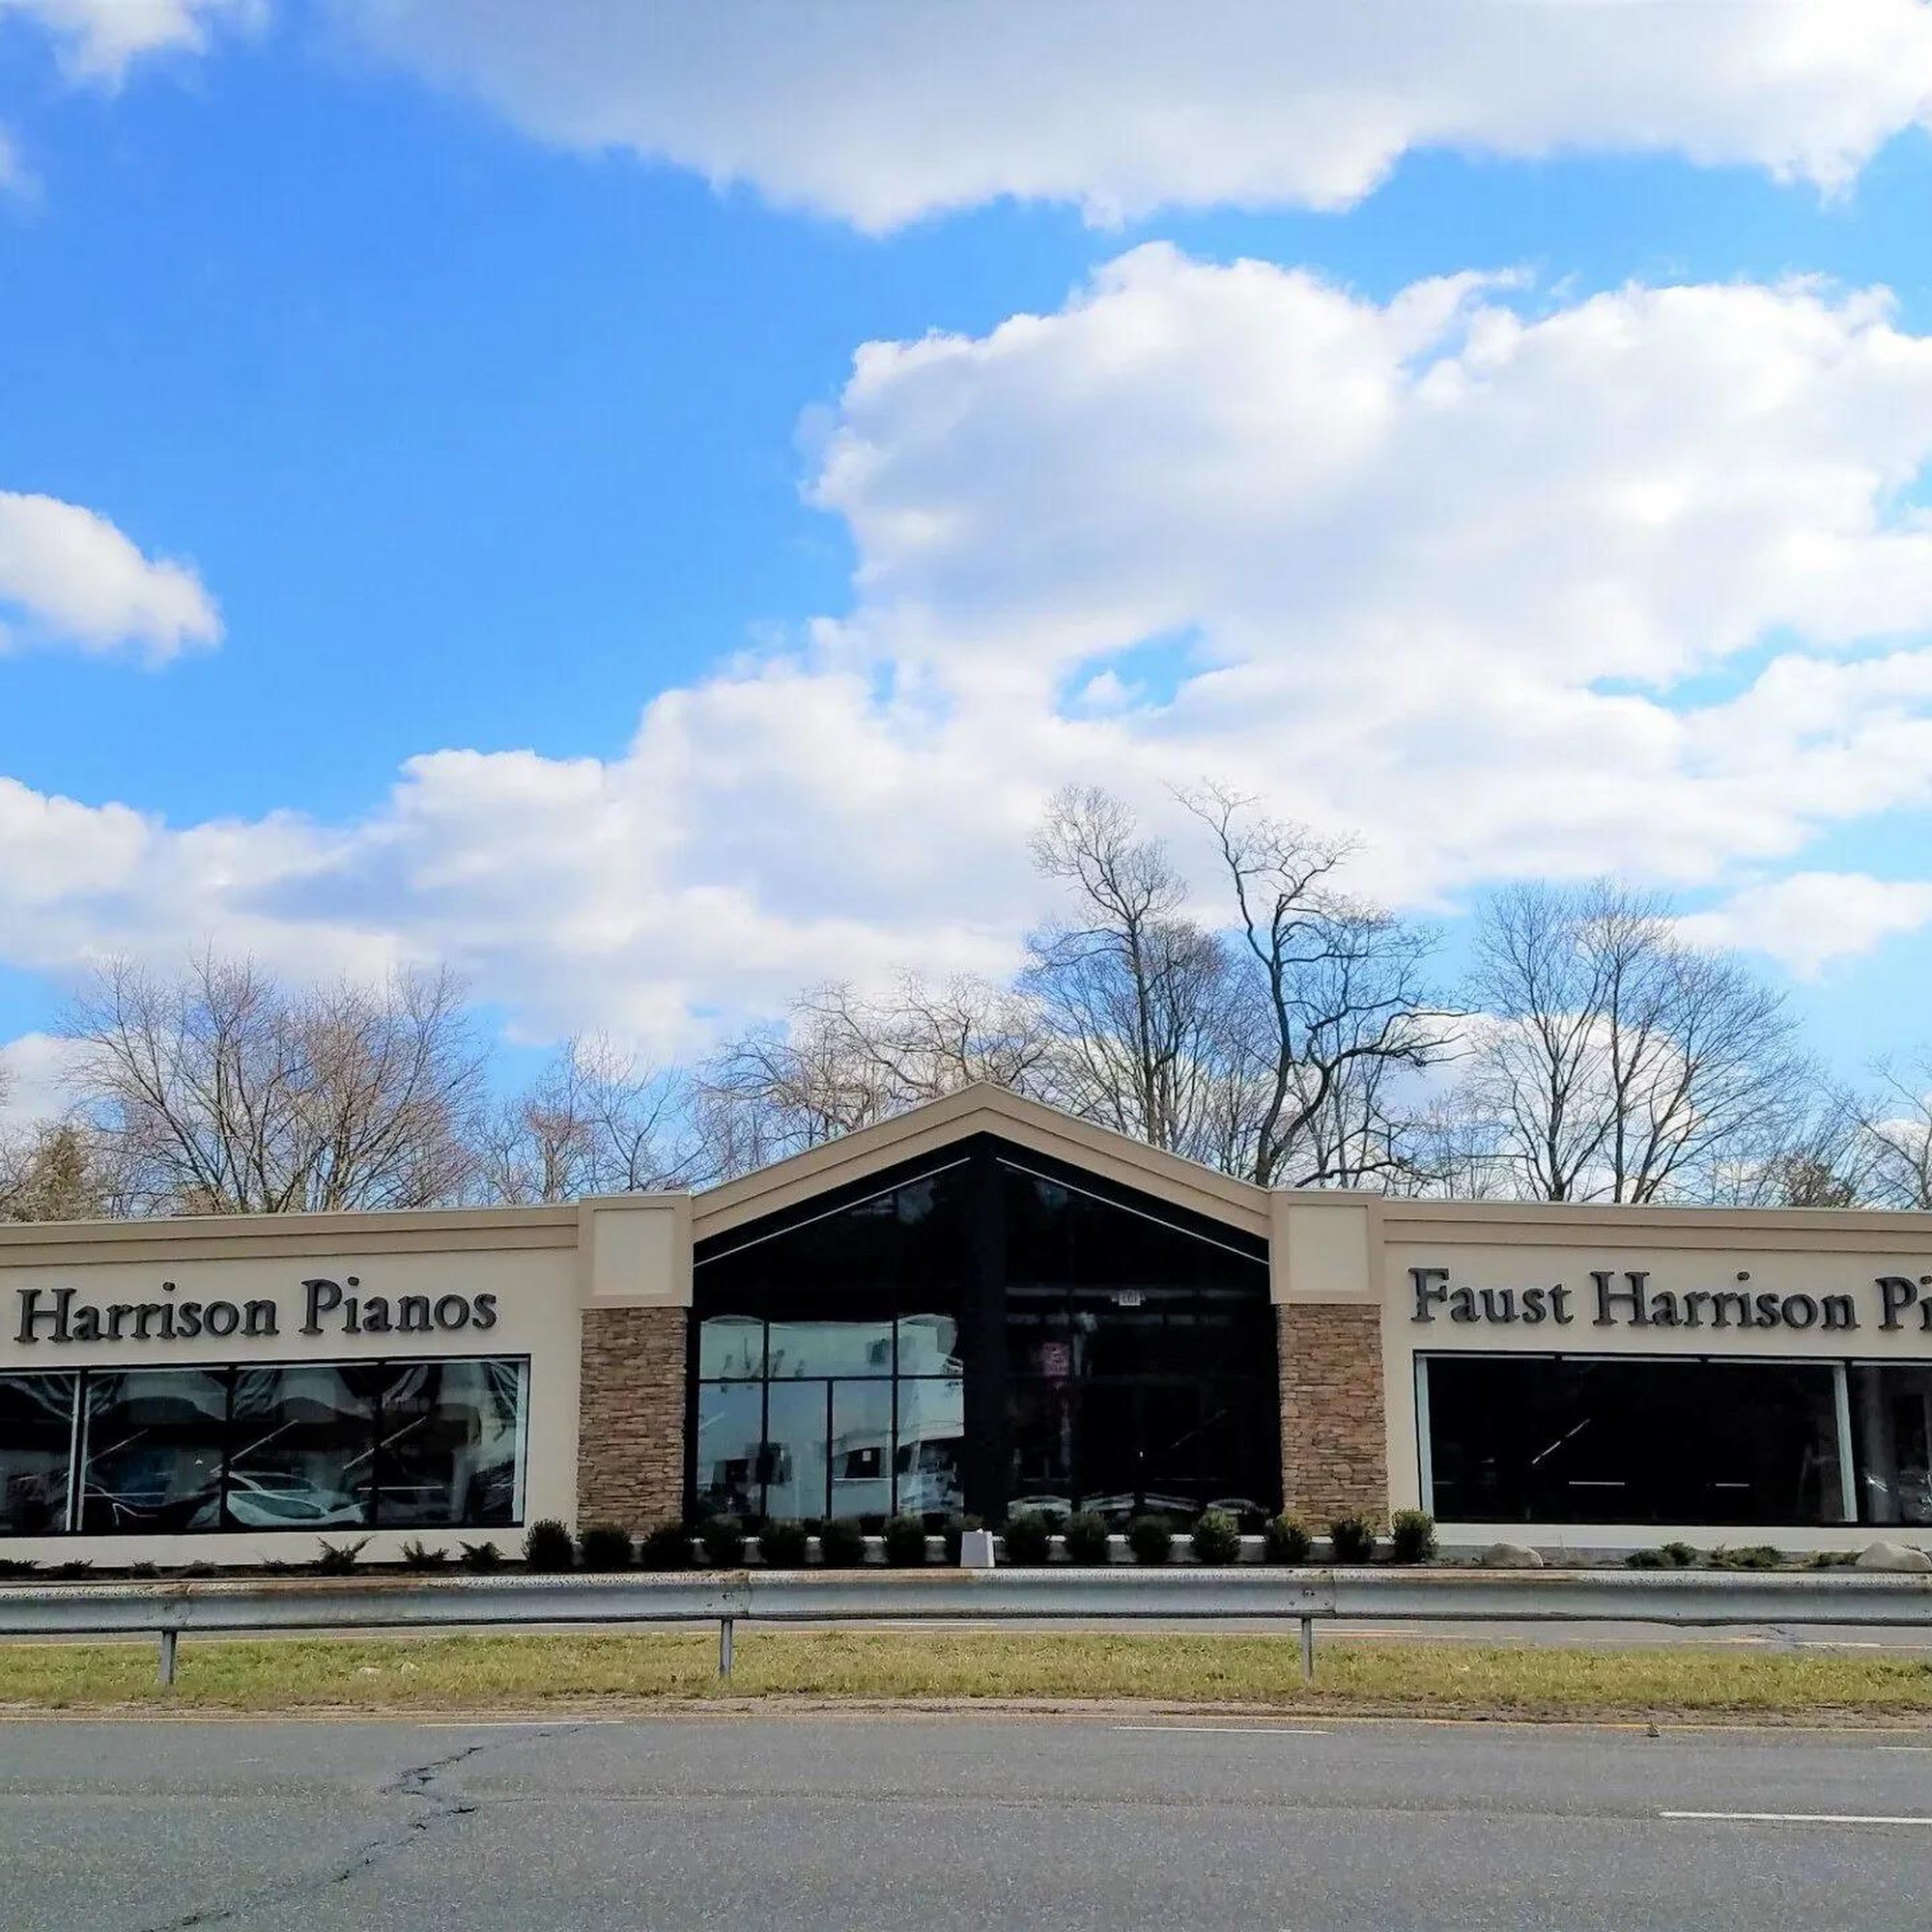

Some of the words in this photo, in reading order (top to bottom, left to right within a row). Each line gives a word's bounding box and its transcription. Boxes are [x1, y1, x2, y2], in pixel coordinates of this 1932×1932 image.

[14, 1282, 279, 1344] Harrison
[298, 1276, 497, 1335] Pianos
[1408, 1267, 1574, 1325] Faust
[1590, 1270, 1861, 1330] Harrison
